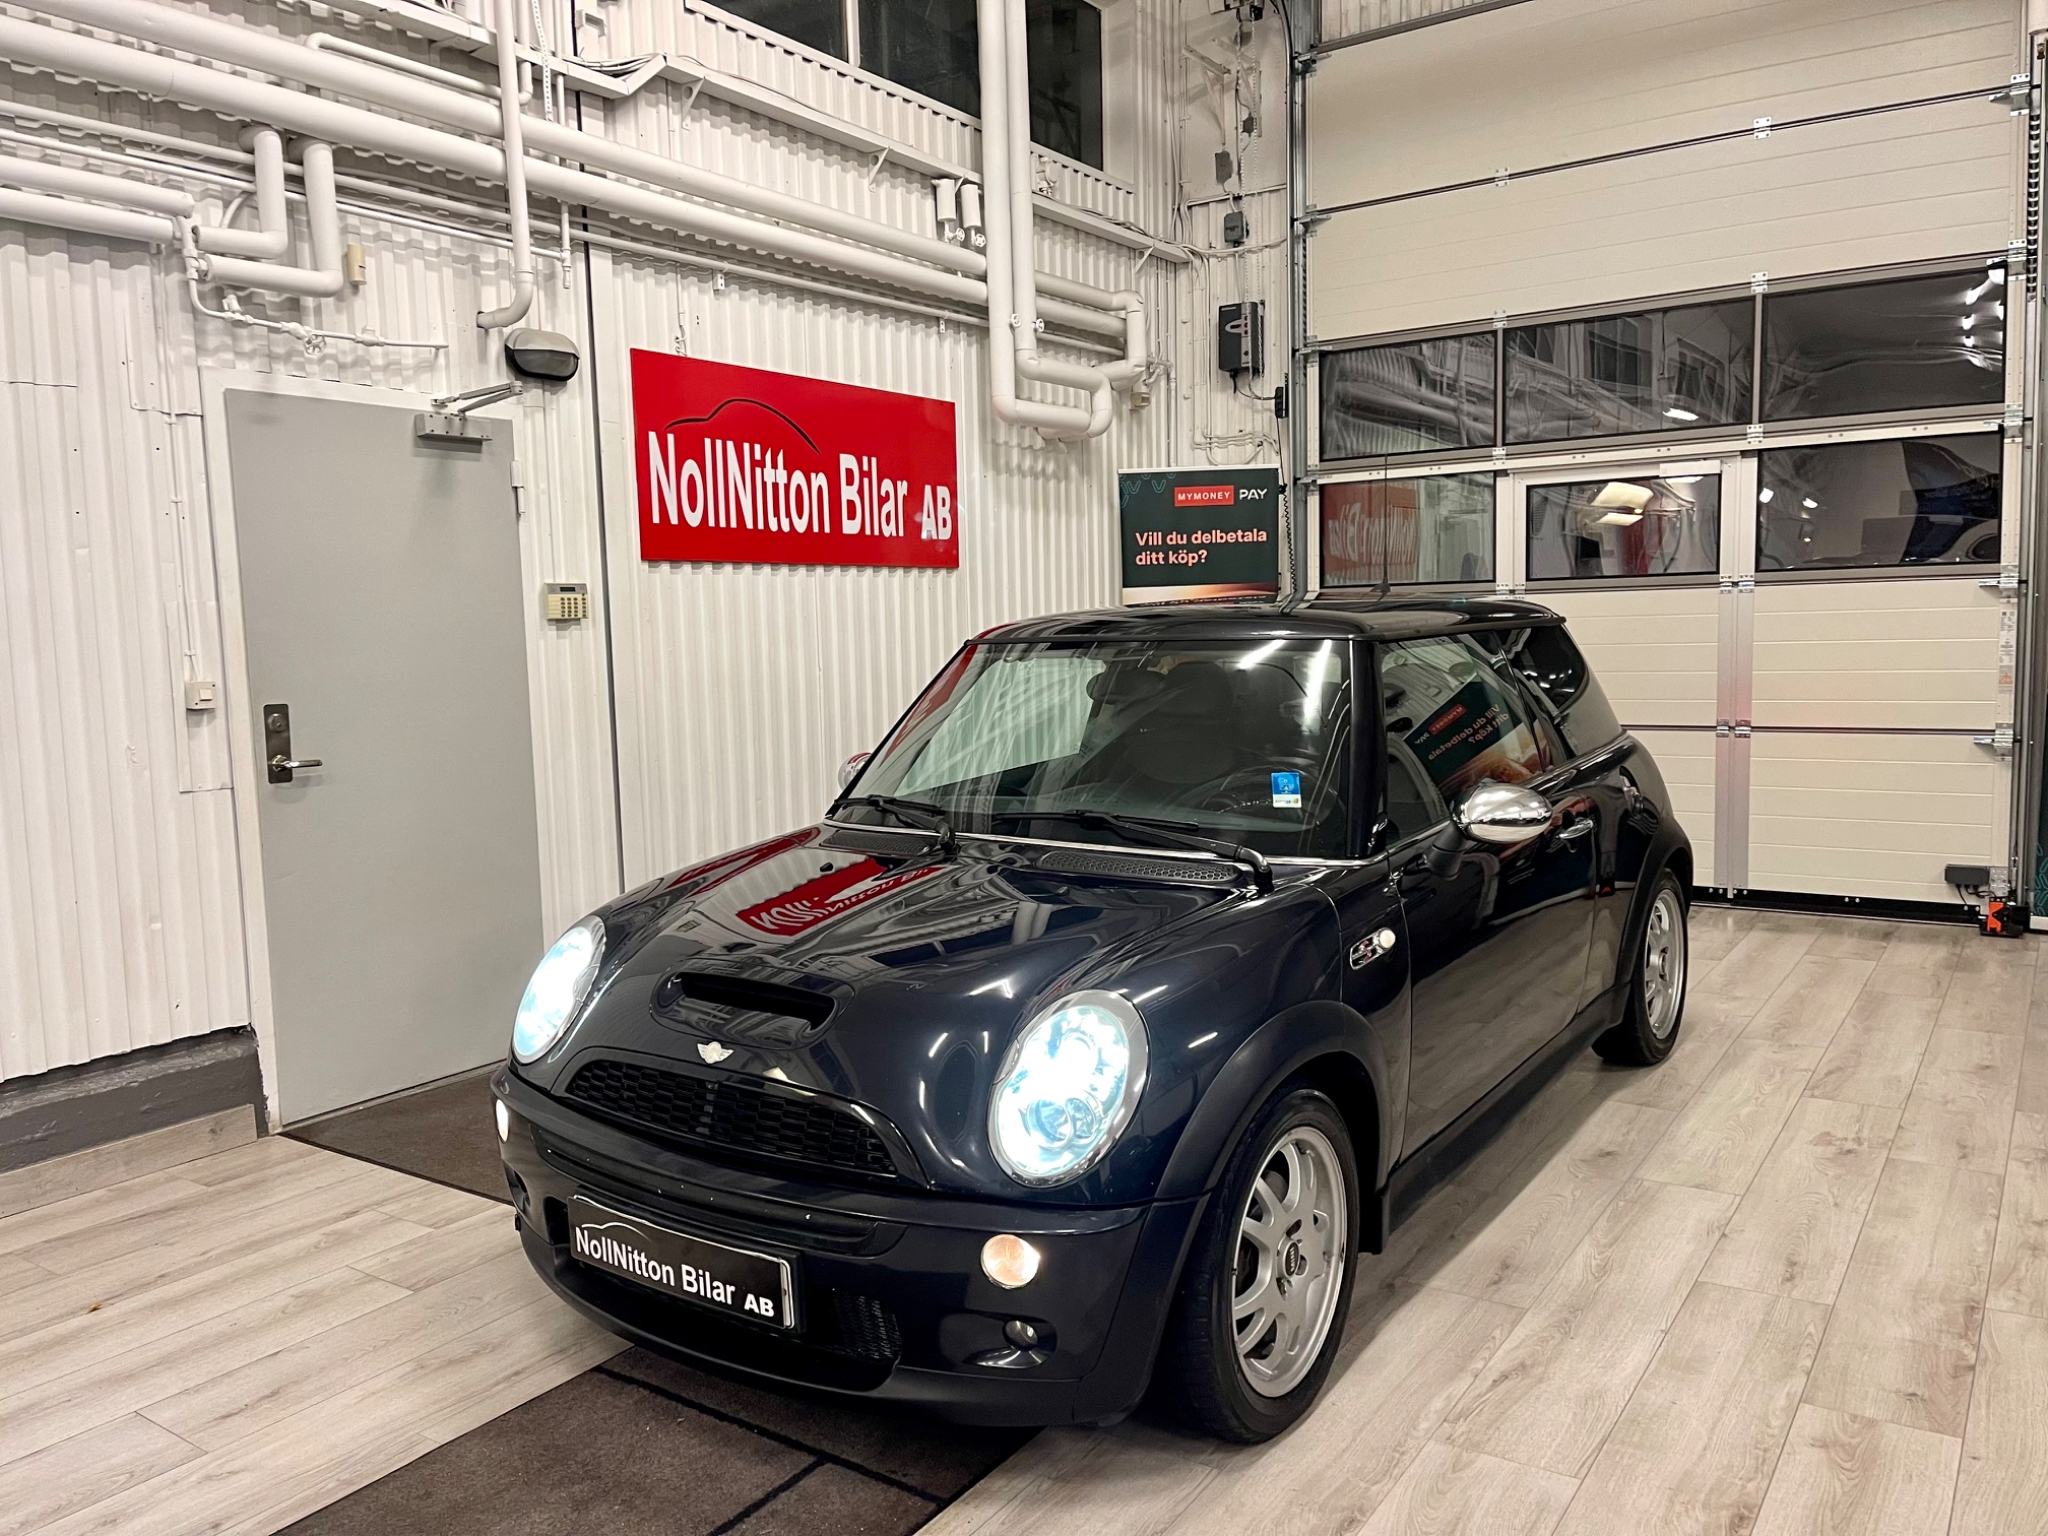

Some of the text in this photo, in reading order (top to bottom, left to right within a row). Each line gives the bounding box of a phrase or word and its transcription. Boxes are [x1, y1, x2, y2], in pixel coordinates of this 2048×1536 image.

[648, 430, 952, 540] NollNitton Bilar AB
[1177, 488, 1268, 501] MYMONEY PAY
[1135, 528, 1267, 546] Vill du delbetala
[1135, 549, 1208, 567] ditt köp?
[575, 1226, 775, 1317] NollNitton Bilar AB
